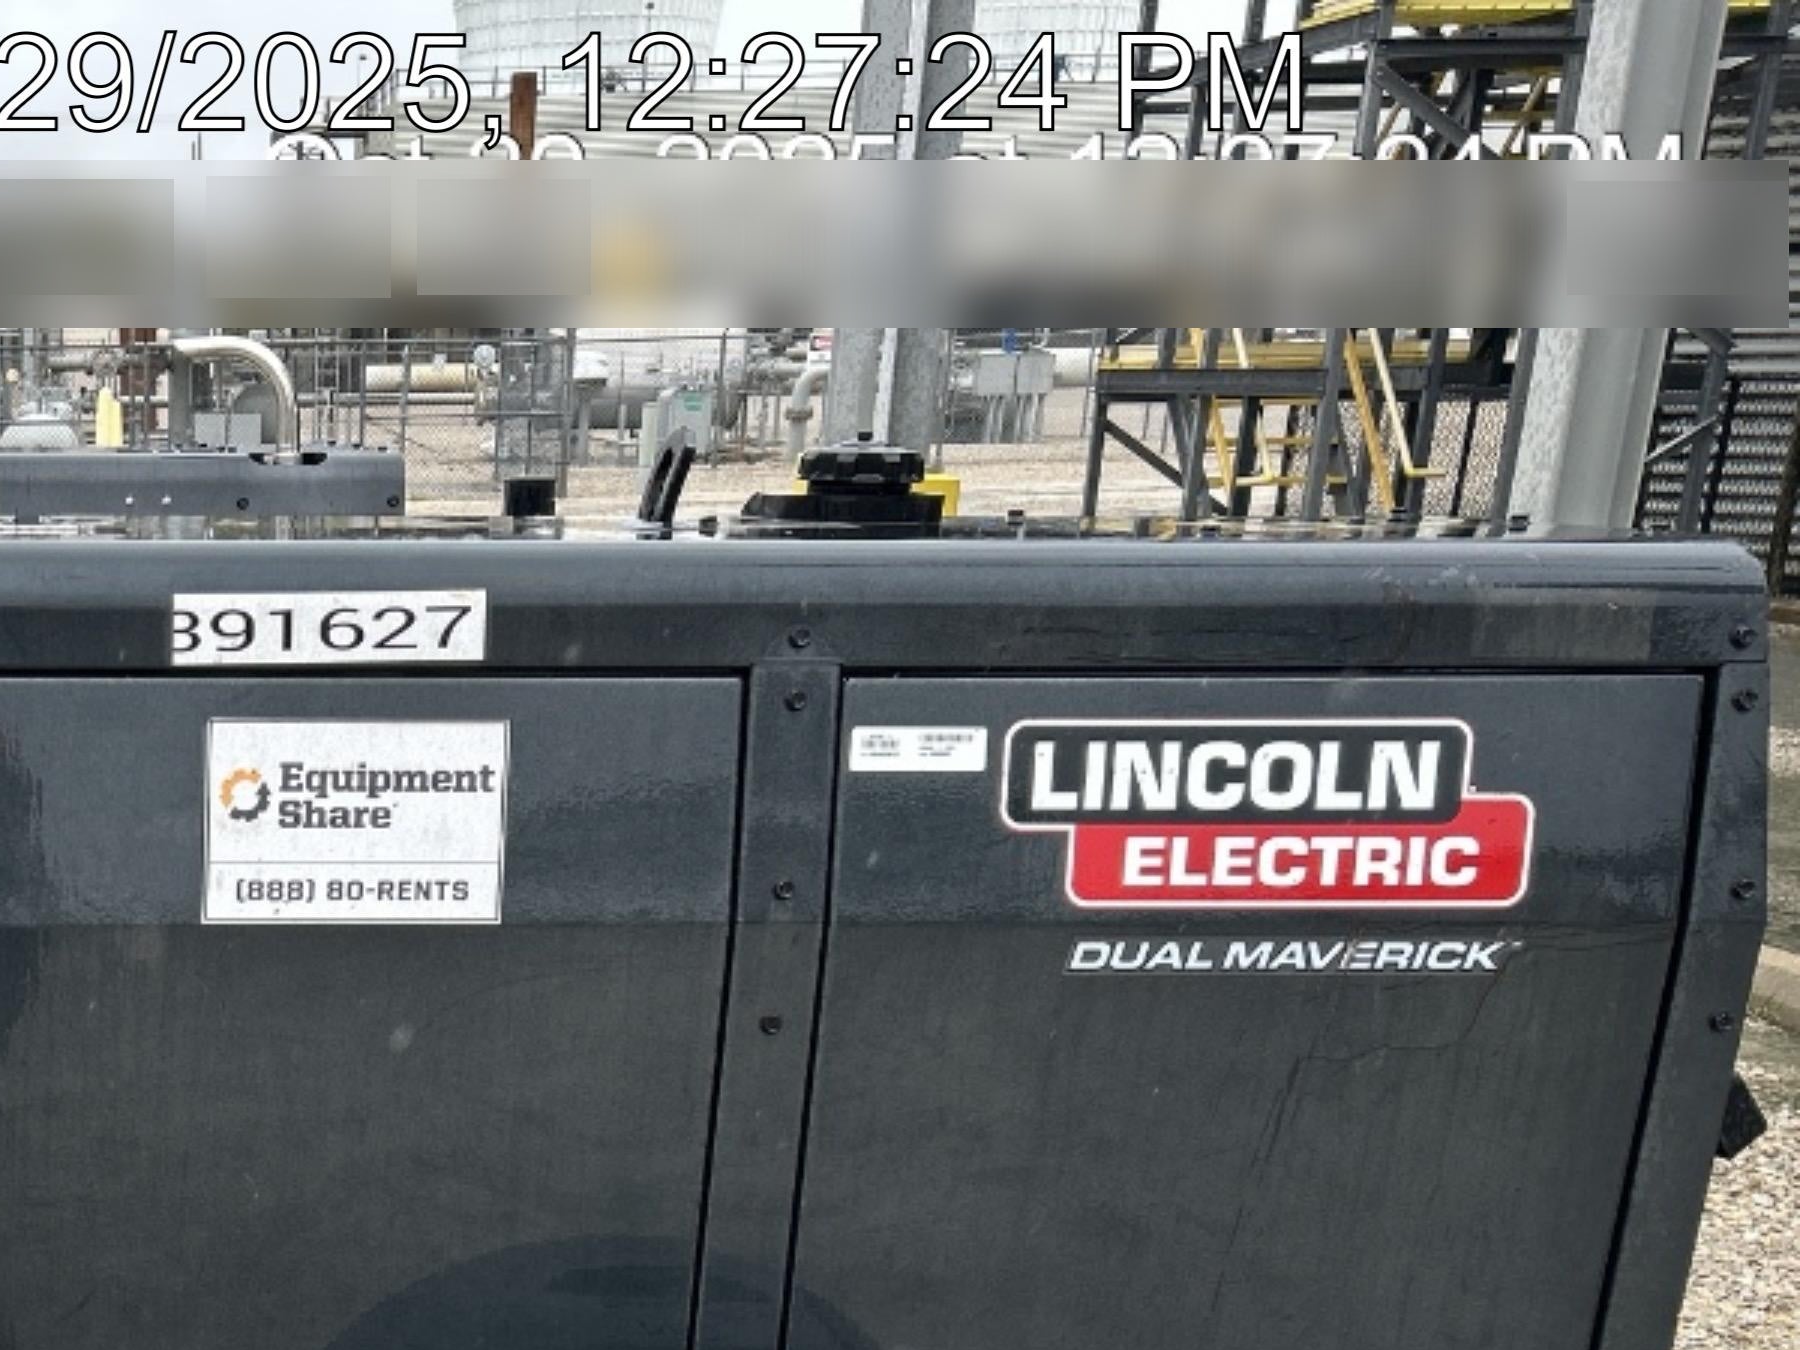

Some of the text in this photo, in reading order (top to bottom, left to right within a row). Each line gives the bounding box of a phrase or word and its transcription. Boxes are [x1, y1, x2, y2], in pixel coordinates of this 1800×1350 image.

[278, 761, 495, 798] Equipment
[1029, 740, 1441, 812] LINCOLN
[278, 799, 393, 829] Share
[1121, 836, 1481, 888] ELECTRIC
[236, 878, 469, 903] (888) 80-RENTS
[1069, 940, 1504, 971] DUAL MAVERICK
